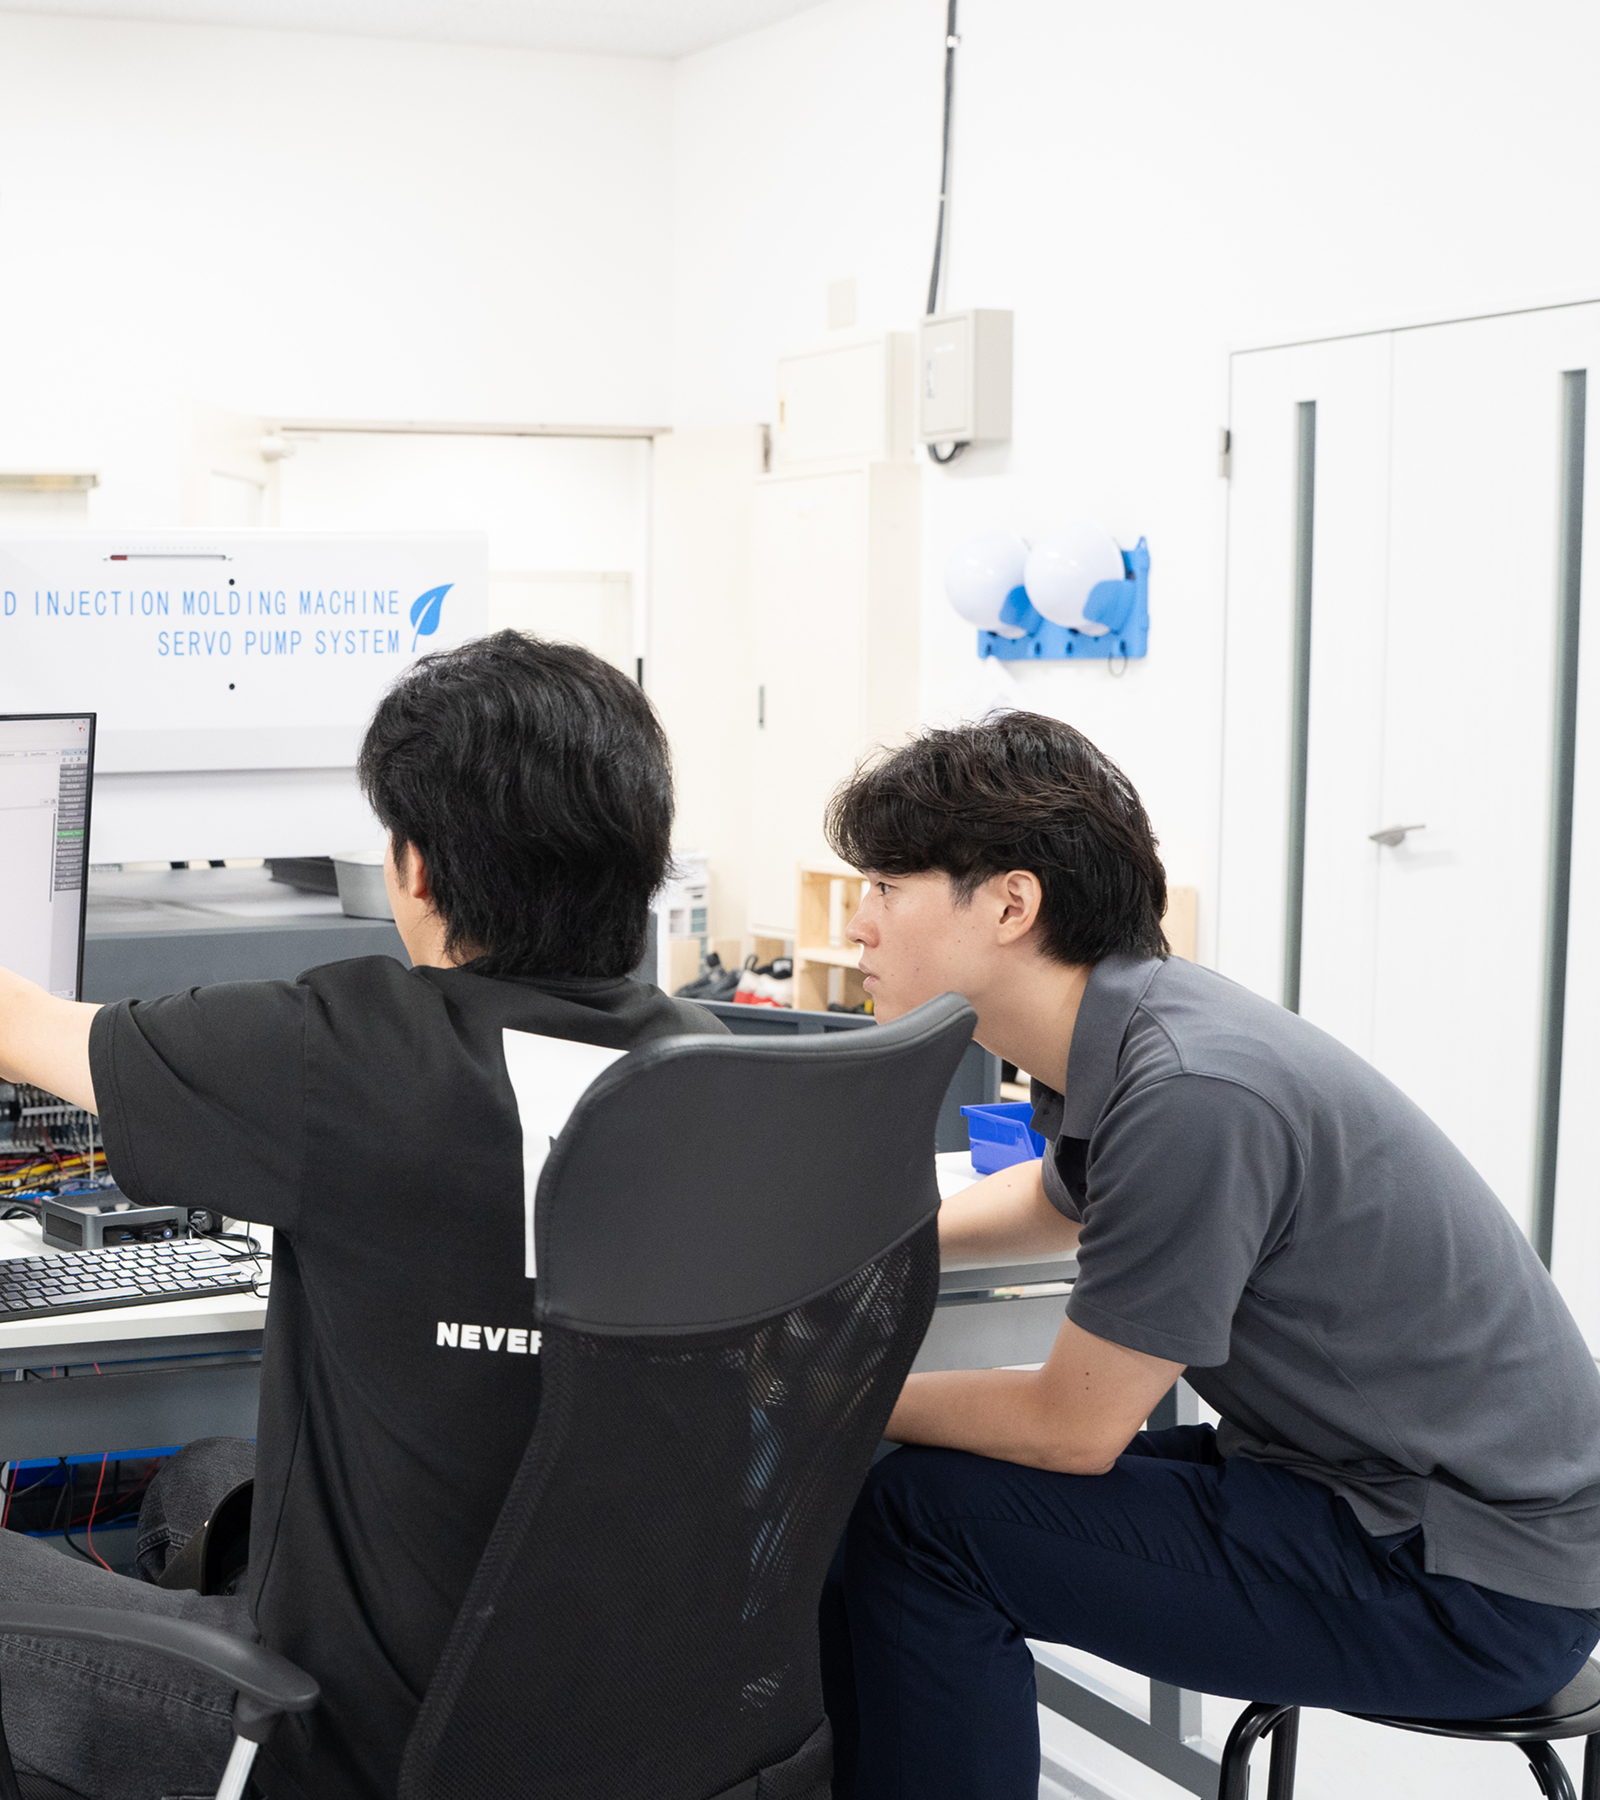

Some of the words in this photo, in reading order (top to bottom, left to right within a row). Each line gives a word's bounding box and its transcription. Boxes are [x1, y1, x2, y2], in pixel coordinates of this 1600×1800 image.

[35, 590, 169, 617] INJECTION
[182, 590, 286, 616] MOLDING
[299, 590, 399, 616] MACHINE
[157, 630, 232, 657] SERVO
[244, 630, 302, 656] PUMP
[314, 629, 400, 655] SYSTEM
